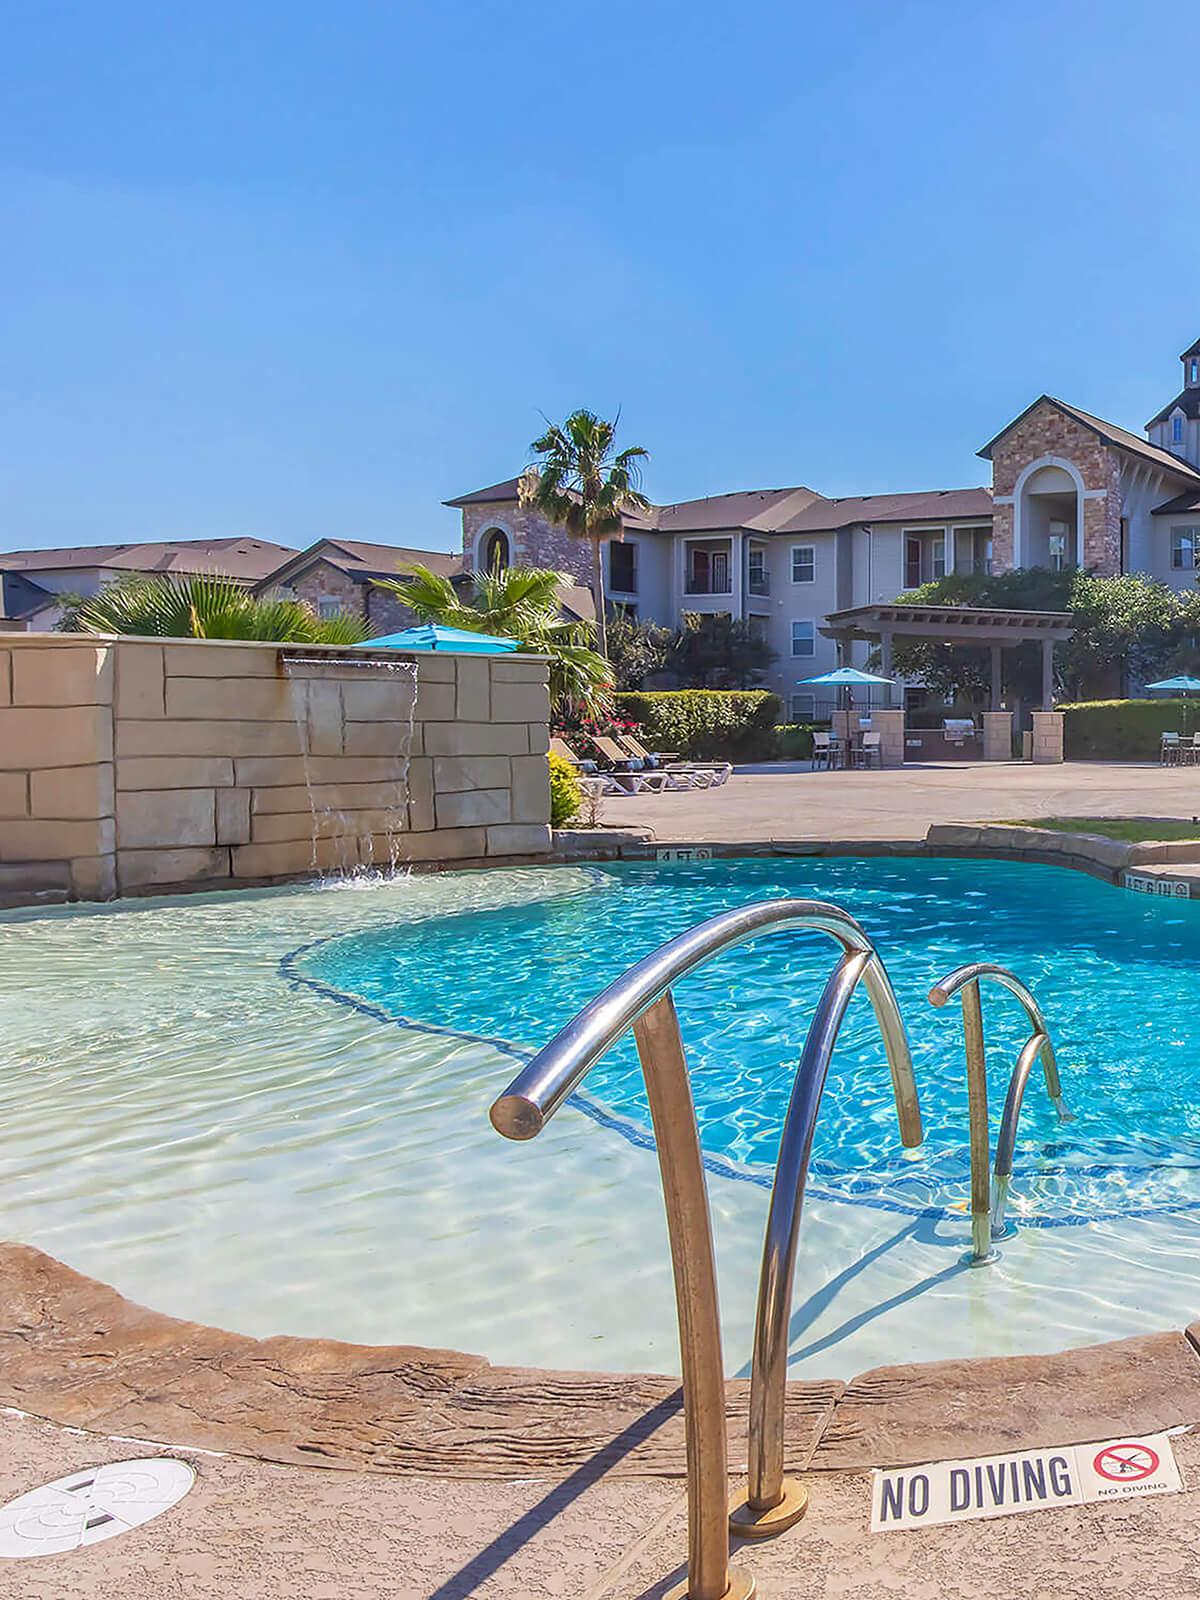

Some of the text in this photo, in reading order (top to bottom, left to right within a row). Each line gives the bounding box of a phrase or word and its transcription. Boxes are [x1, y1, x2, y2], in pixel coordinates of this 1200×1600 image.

[880, 1456, 1073, 1522] NO DIVING
[1098, 1483, 1168, 1497] NO DIVING
